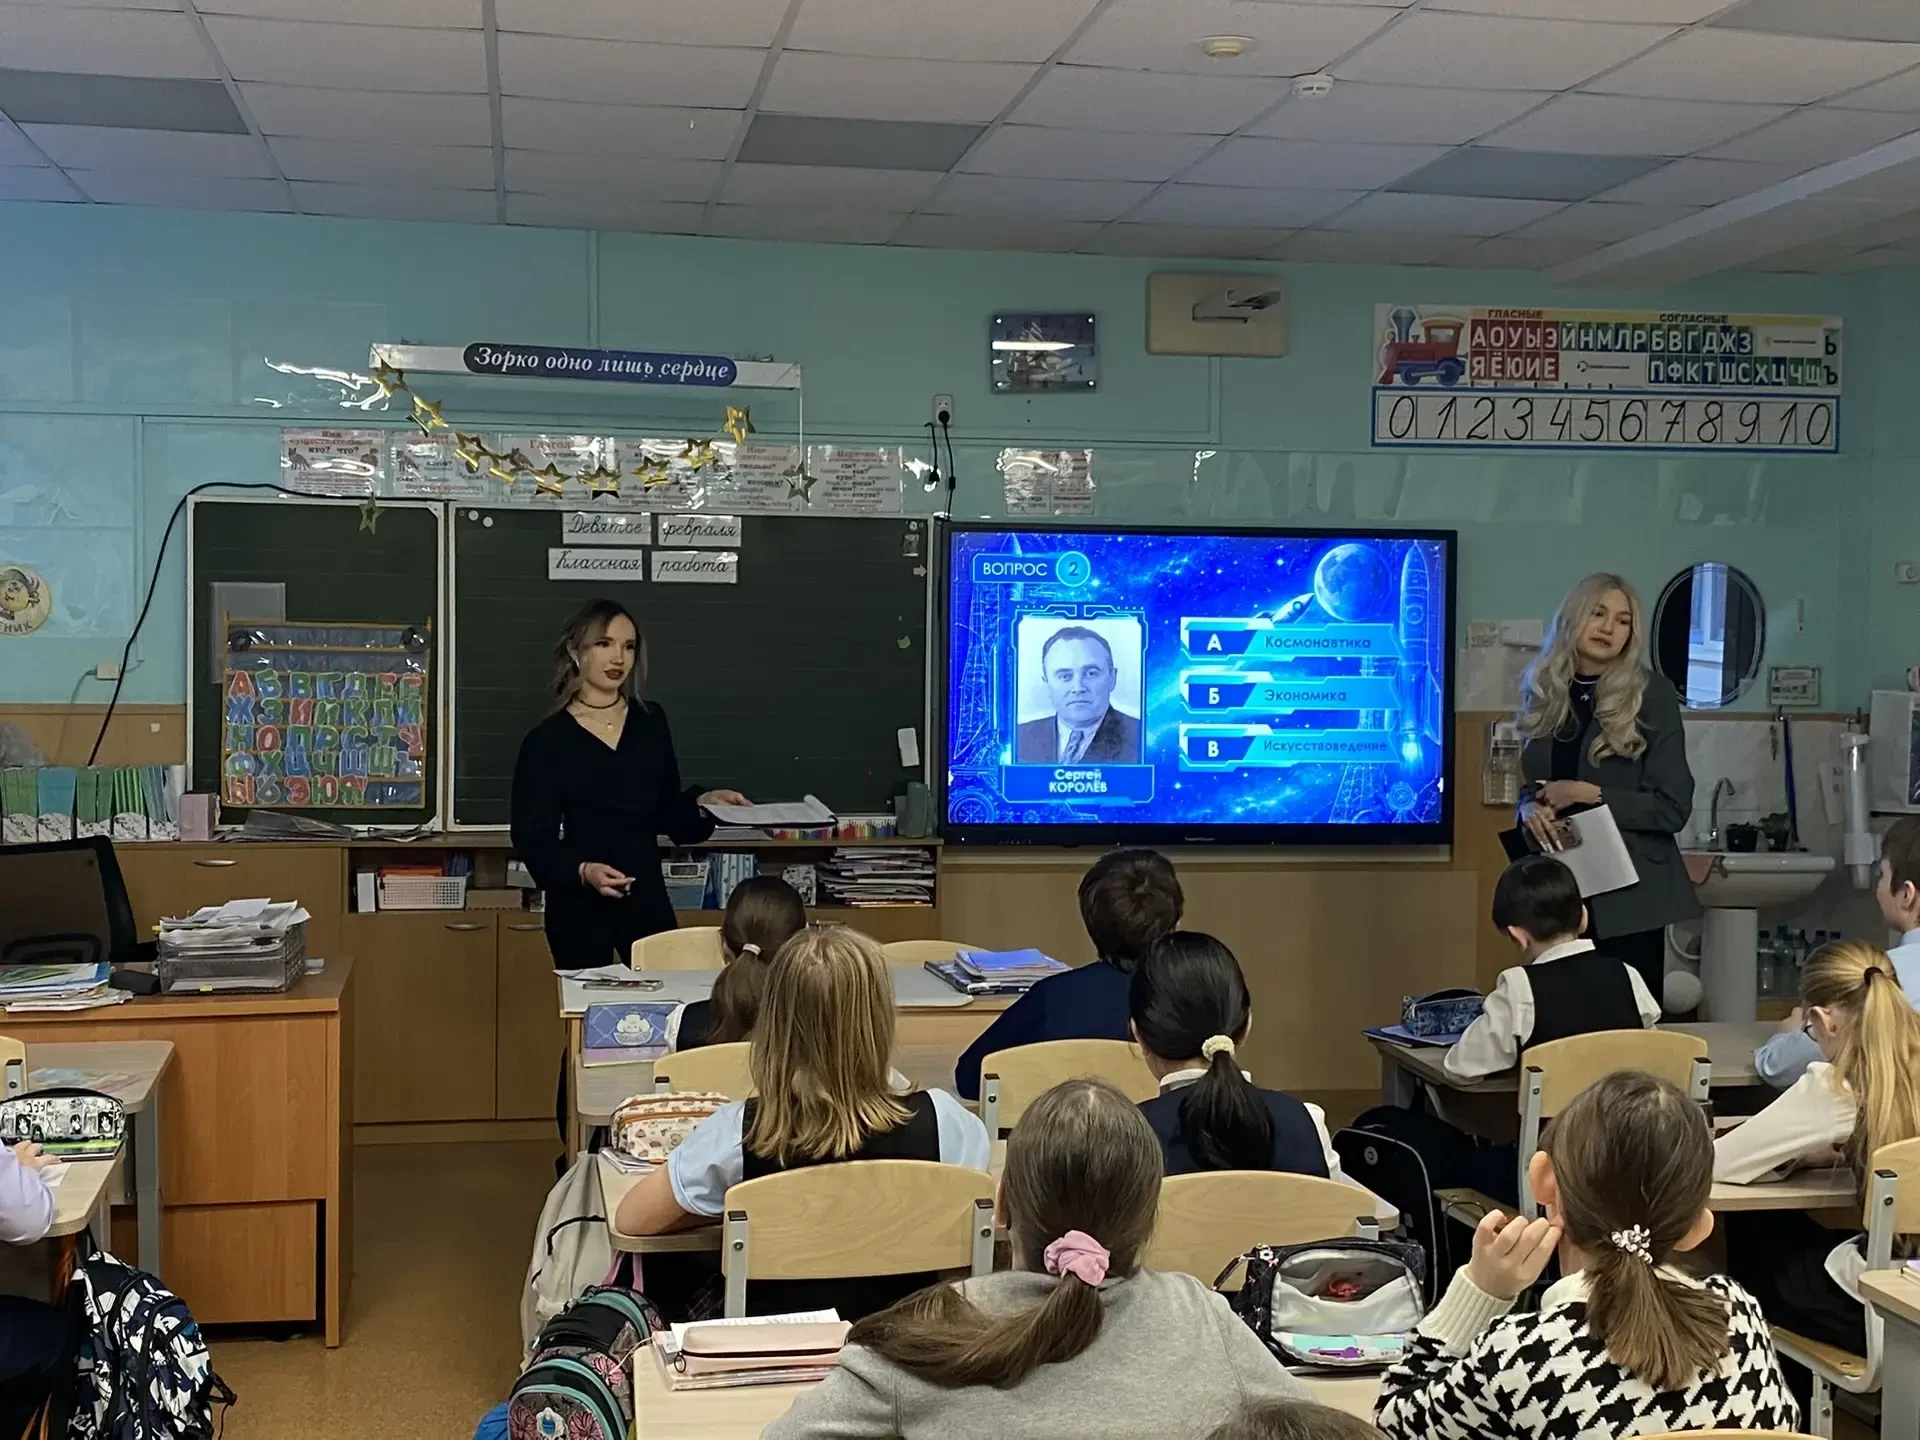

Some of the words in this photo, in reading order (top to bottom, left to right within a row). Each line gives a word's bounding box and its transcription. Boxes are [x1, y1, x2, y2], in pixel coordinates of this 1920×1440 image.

[1488, 309, 1543, 319] ГЛАСНЫЕ
[1659, 313, 1729, 324] СОГЛАСНЫЕ
[474, 347, 539, 372] Зорко
[545, 350, 592, 371] одно
[597, 356, 654, 375] лишь
[660, 358, 729, 381] сердце
[1389, 395, 1415, 438] 0
[1438, 397, 1457, 439] 1
[1467, 396, 1495, 440] 2
[1504, 397, 1533, 440] 3
[1549, 399, 1571, 441] 4
[1579, 399, 1610, 442] 5
[1619, 399, 1647, 442] 6
[1661, 400, 1686, 442] 7
[1697, 401, 1722, 443] 8
[1735, 402, 1760, 444] 9
[568, 514, 642, 534] Девятое
[662, 517, 737, 543] февраля
[556, 549, 641, 570] Классная
[656, 554, 729, 579] работа
[983, 562, 1048, 576] ВОПРОС
[1068, 561, 1080, 577] 2
[1207, 633, 1223, 652] А
[1265, 635, 1371, 649] Космонавтика
[1208, 687, 1221, 705] Б
[1264, 688, 1347, 702] Экономика
[1207, 740, 1220, 758] В
[1264, 739, 1388, 753] Искусствоведение
[1054, 768, 1102, 782] Сергей
